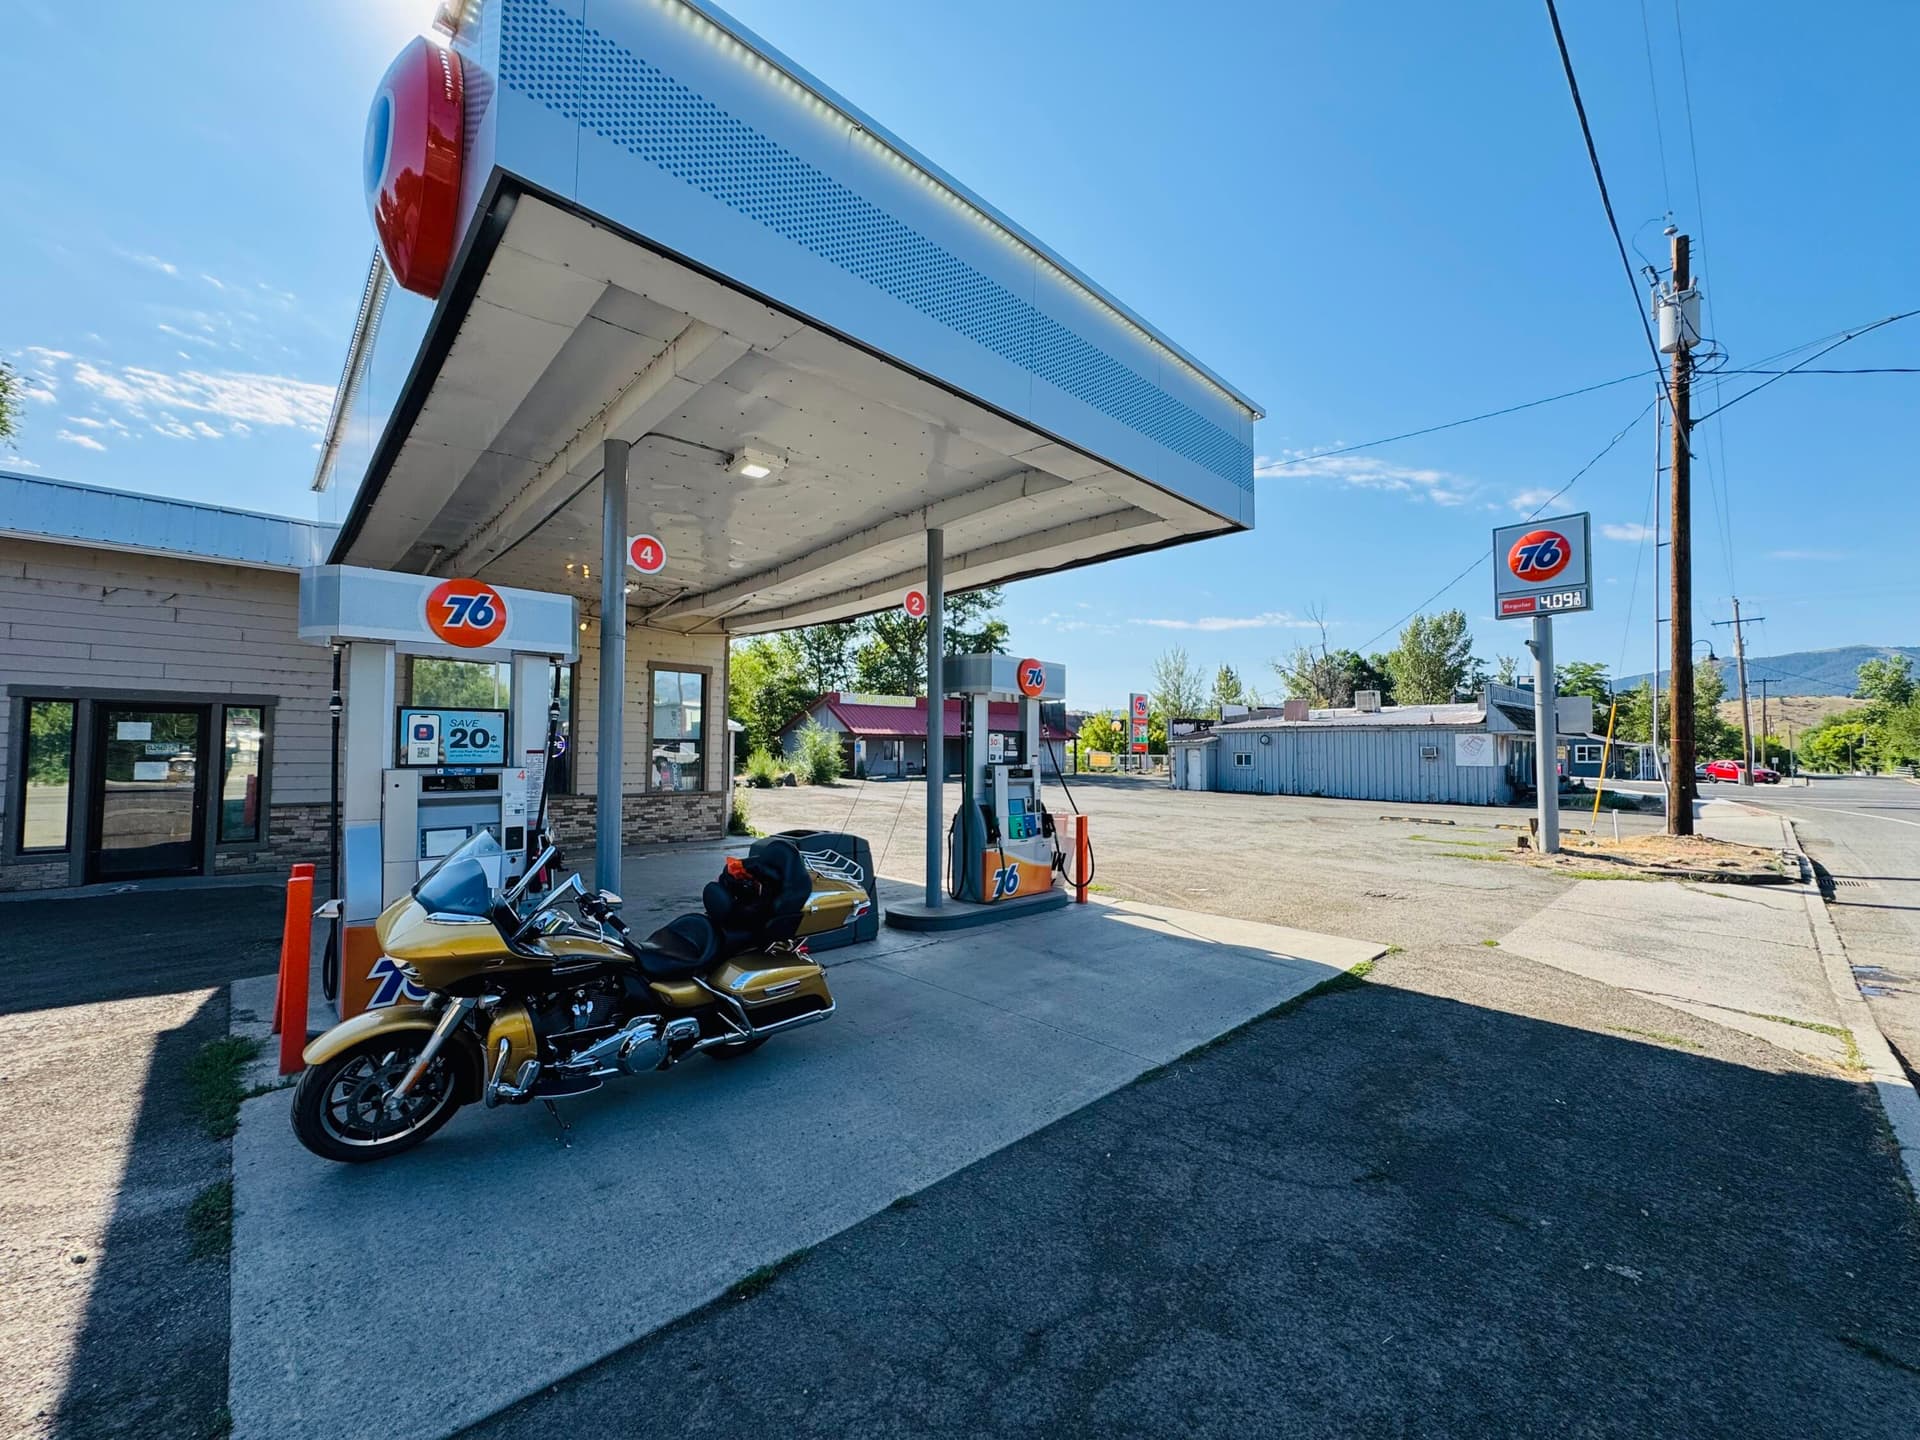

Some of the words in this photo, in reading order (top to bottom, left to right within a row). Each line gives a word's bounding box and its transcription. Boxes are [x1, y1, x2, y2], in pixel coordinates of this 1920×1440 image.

[640, 545, 654, 563] 4
[1517, 537, 1562, 573] 76
[442, 593, 498, 629] 76
[911, 596, 921, 611] 2
[1503, 602, 1532, 610] Regular
[1026, 666, 1044, 688] 76
[1137, 702, 1146, 712] 76
[449, 719, 480, 728] SAVE
[517, 769, 526, 780] 4
[991, 862, 1021, 898] 76
[365, 957, 430, 1010] 7
